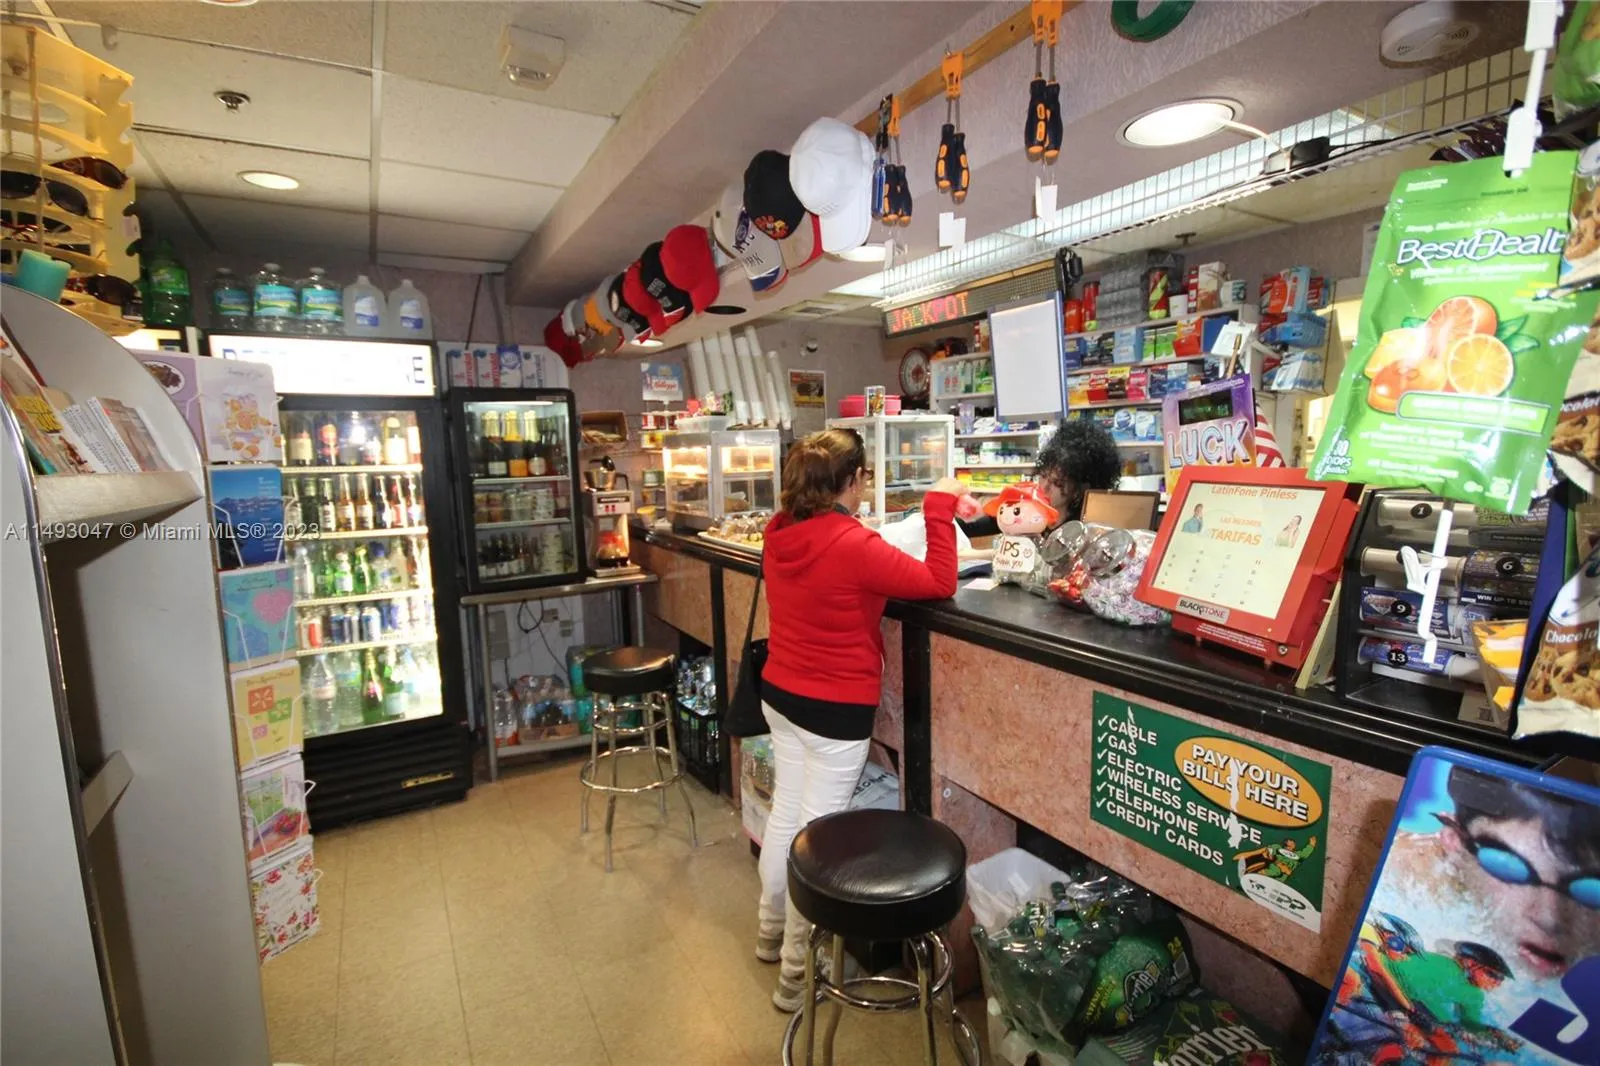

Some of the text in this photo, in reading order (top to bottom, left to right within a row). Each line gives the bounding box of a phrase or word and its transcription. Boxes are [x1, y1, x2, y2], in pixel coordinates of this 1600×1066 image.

[1397, 228, 1568, 265] BestHealt
[890, 292, 969, 333] JACKPOT
[1168, 420, 1250, 468] LUCK
[1211, 486, 1297, 500] LatinFone Pinless
[1210, 528, 1262, 545] TARIFAS
[1502, 561, 1513, 571] 6
[1179, 599, 1227, 619] BLACKSTONE
[1396, 604, 1407, 613] 9
[1477, 594, 1492, 602] WIN
[1545, 628, 1597, 644] Chocola
[1390, 652, 1406, 663] 13
[1108, 718, 1157, 746] CABLE
[1108, 735, 1137, 756] GAS
[1107, 752, 1182, 791] ELECTRIC
[1192, 744, 1298, 795] PAY YOUR
[1107, 769, 1262, 845] WIRELESS SERVCE
[1107, 785, 1199, 837] TELEPHONE
[1245, 783, 1309, 822] HERE
[1107, 802, 1224, 866] CREDIT CARDS
[1156, 1024, 1273, 1066] errier
